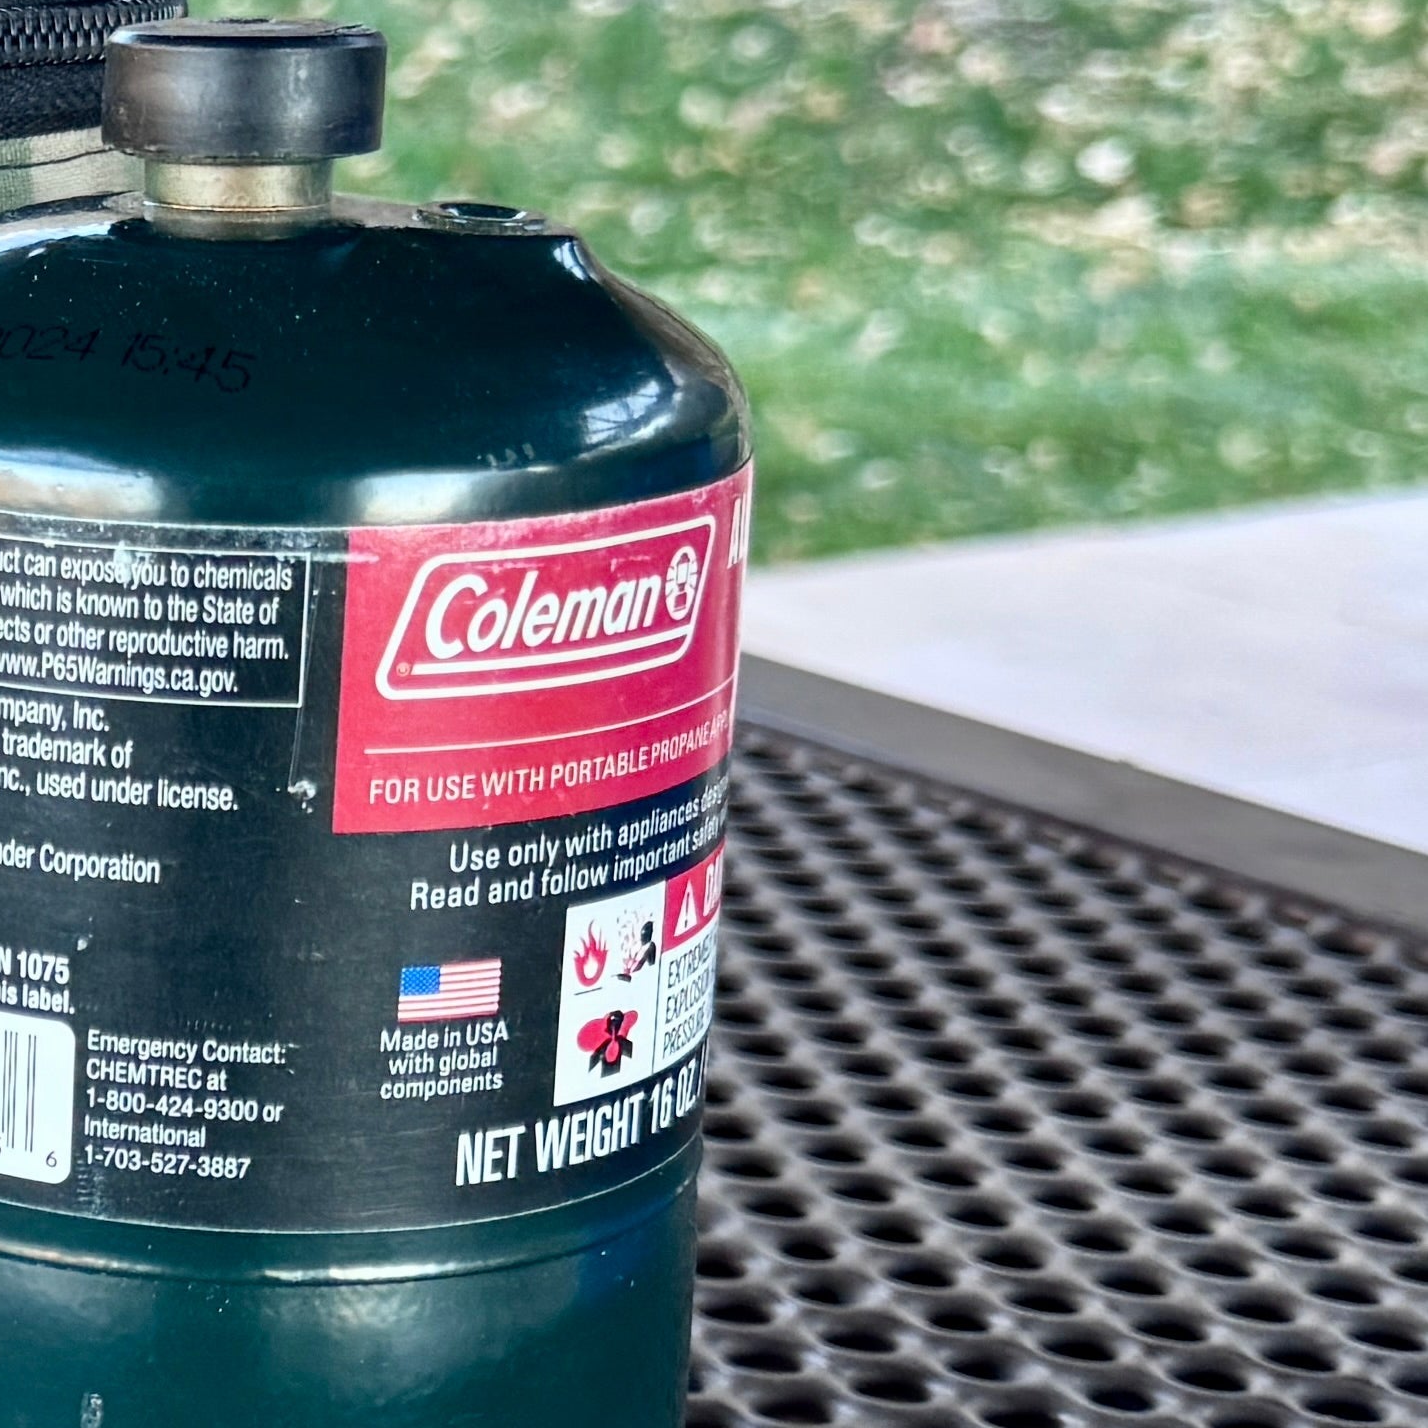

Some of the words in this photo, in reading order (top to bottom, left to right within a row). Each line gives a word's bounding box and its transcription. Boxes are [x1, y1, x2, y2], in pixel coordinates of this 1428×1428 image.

[121, 333, 255, 393] 15:45
[24, 556, 56, 577] can
[61, 558, 126, 585] expose
[131, 560, 165, 590] you
[170, 560, 189, 587] to
[194, 561, 292, 591] chemicals
[425, 570, 662, 659] Coleman
[34, 623, 53, 644] or
[57, 622, 105, 649] other
[109, 628, 228, 659] reproductive
[233, 632, 289, 660] harm.
[73, 700, 109, 731] Inc.
[369, 780, 419, 805] FOR
[427, 774, 475, 801] USE
[481, 767, 543, 797] WITH
[550, 747, 648, 789] PORTABLE
[650, 725, 712, 768] PROPANE
[37, 772, 85, 799] used
[91, 776, 152, 805] under
[158, 779, 238, 810] license.
[450, 840, 499, 873] Use
[509, 834, 559, 868] only
[566, 827, 611, 857] with
[618, 797, 698, 846] appliances
[40, 843, 160, 884] Corporation
[410, 876, 478, 910] Read
[488, 874, 534, 904] and
[542, 863, 607, 897] follow
[613, 835, 690, 882] important
[17, 951, 69, 984] 1075
[87, 1031, 198, 1063] Emergency
[203, 1041, 286, 1065] Contact:
[380, 1028, 435, 1051] Made
[444, 1026, 460, 1048] in
[466, 1021, 509, 1044] USA
[86, 1059, 202, 1090] CHEMTREC
[207, 1071, 227, 1092] at
[388, 1048, 433, 1076] with
[440, 1048, 497, 1077] global
[380, 1071, 503, 1101] components
[86, 1088, 257, 1123] 1-800-424-9300
[263, 1104, 283, 1121] or
[84, 1115, 206, 1148] International
[456, 1126, 526, 1187] NET
[535, 1089, 643, 1173] WEIGHT
[648, 1079, 672, 1134] 16
[46, 1150, 57, 1168] 6
[85, 1145, 251, 1179] 1-703-527-3887
